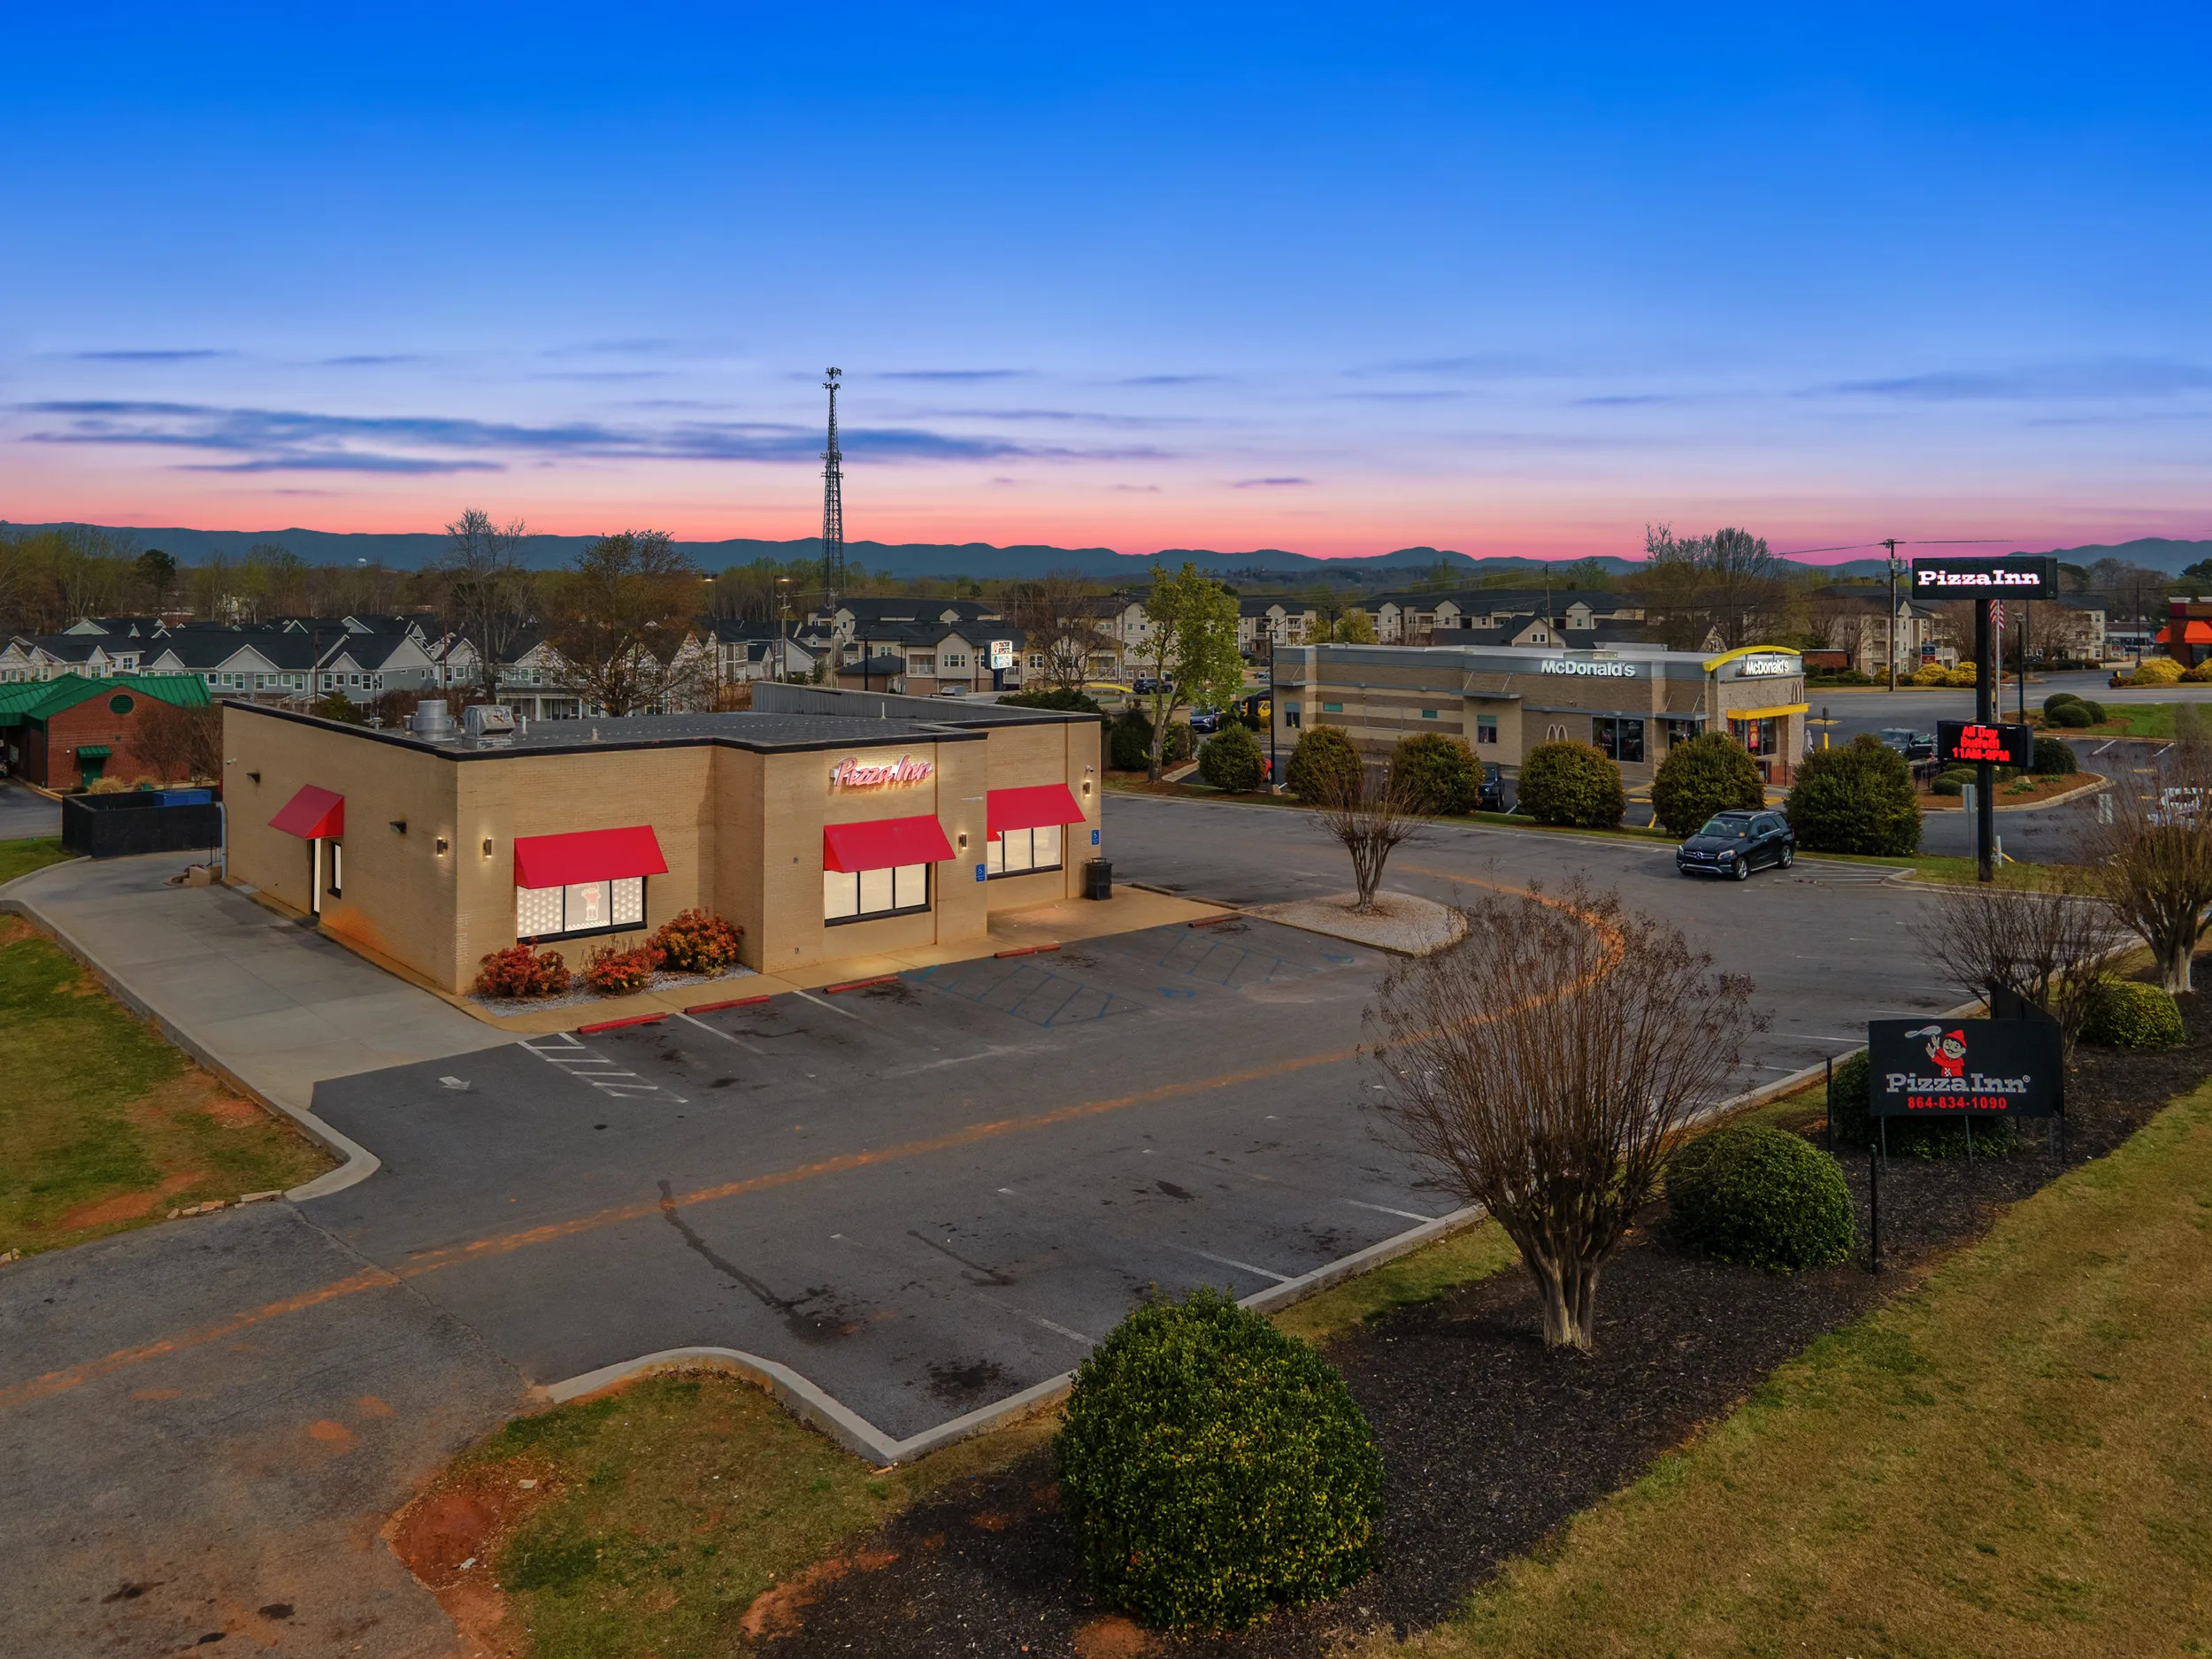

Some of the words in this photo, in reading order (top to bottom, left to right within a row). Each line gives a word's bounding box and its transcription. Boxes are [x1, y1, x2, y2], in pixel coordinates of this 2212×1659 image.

[1917, 570, 1991, 586] Pizza
[1992, 569, 2040, 585] Inn
[1540, 659, 1636, 677] McDonald's
[1746, 659, 1789, 675] McDonald's
[834, 757, 894, 787] Pizza
[894, 755, 933, 782] Inn
[1886, 1073, 1970, 1094] Pizza
[1908, 1095, 2008, 1110] 864-834-1090
